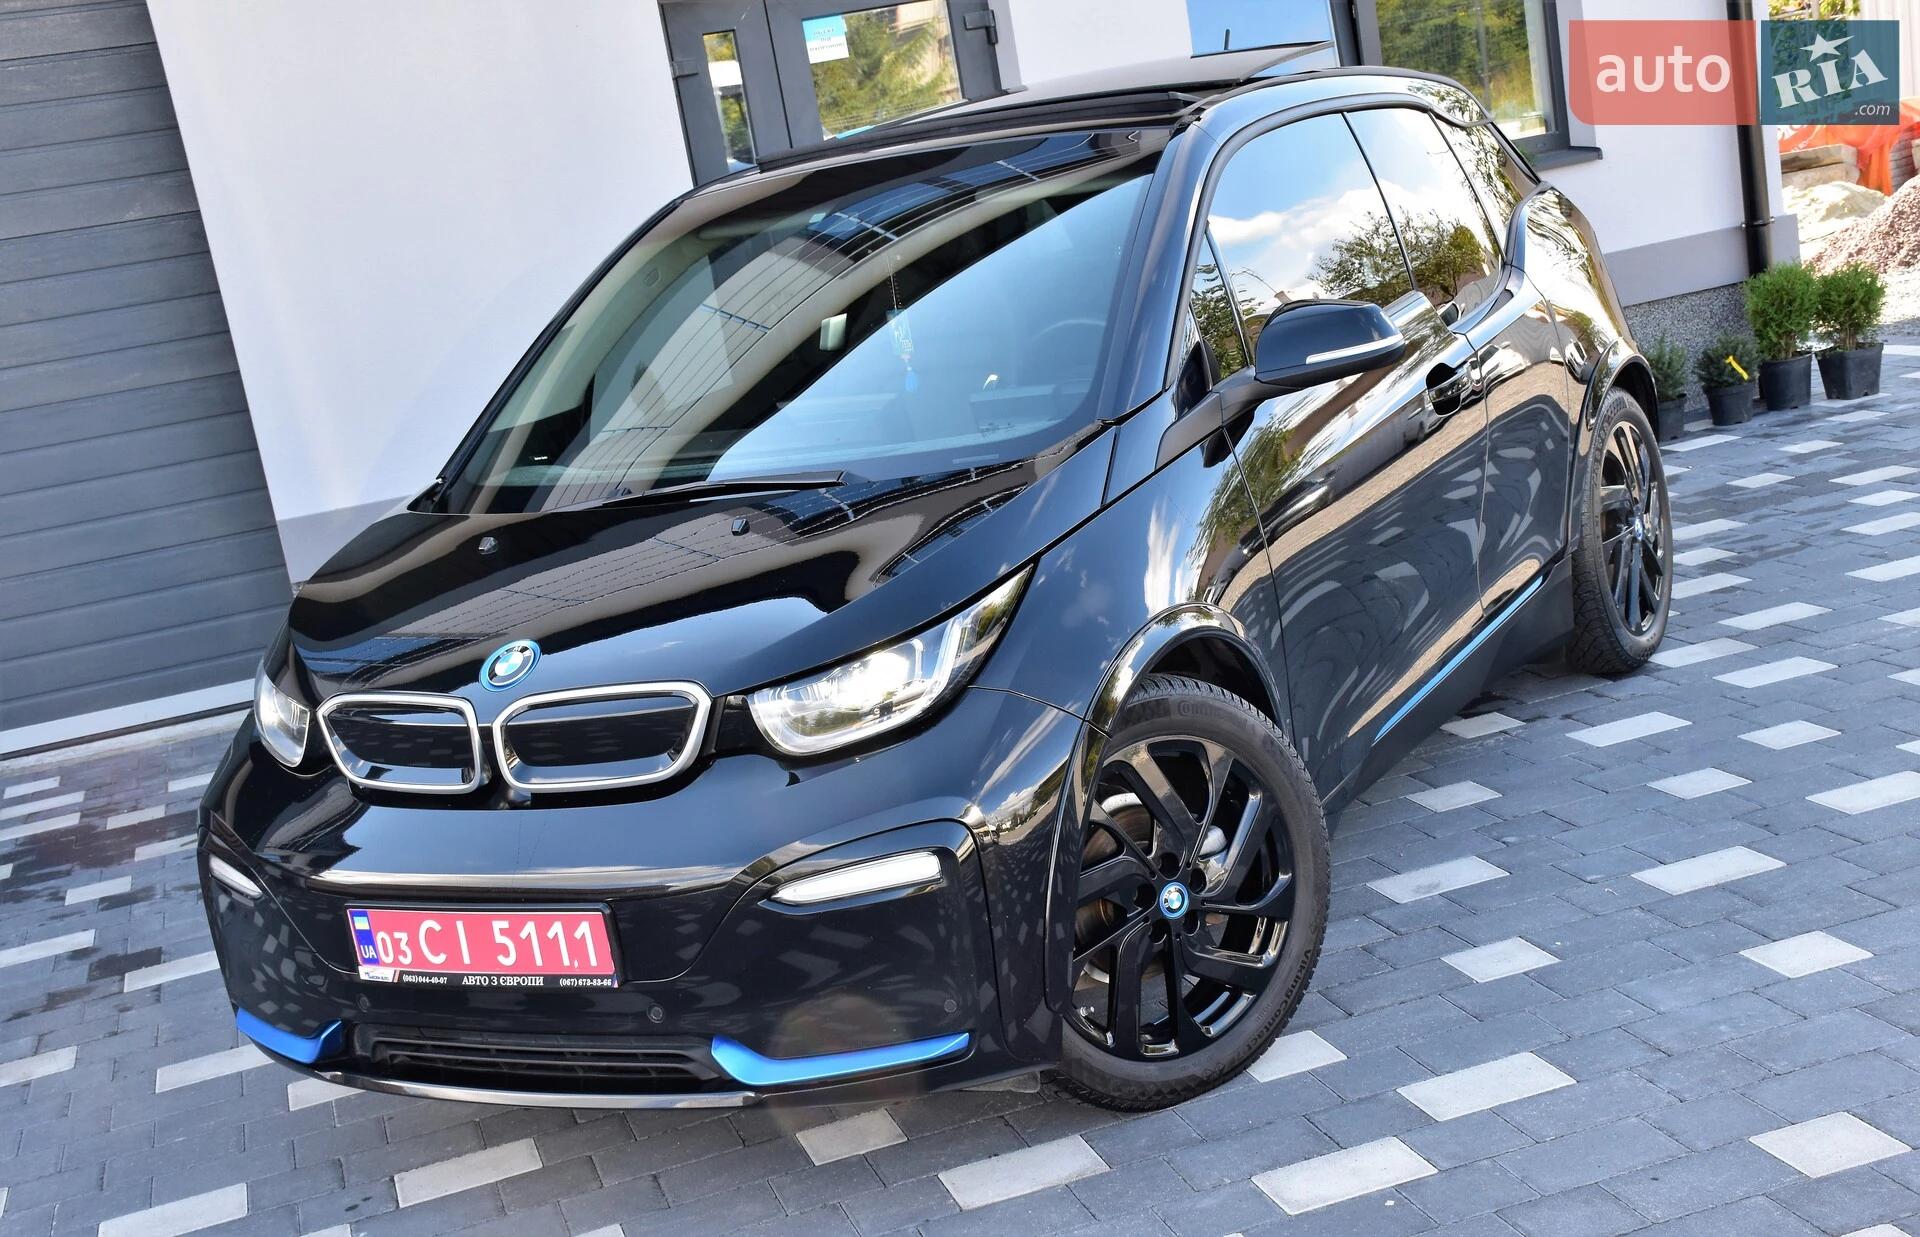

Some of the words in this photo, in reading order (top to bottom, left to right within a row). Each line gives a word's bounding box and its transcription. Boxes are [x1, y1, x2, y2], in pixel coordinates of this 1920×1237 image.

[376, 930, 413, 965] 03
[491, 920, 598, 967] 5111
[361, 945, 377, 959] UA
[462, 976, 489, 987] АВТО
[499, 976, 544, 987] ЄВРОПИ
